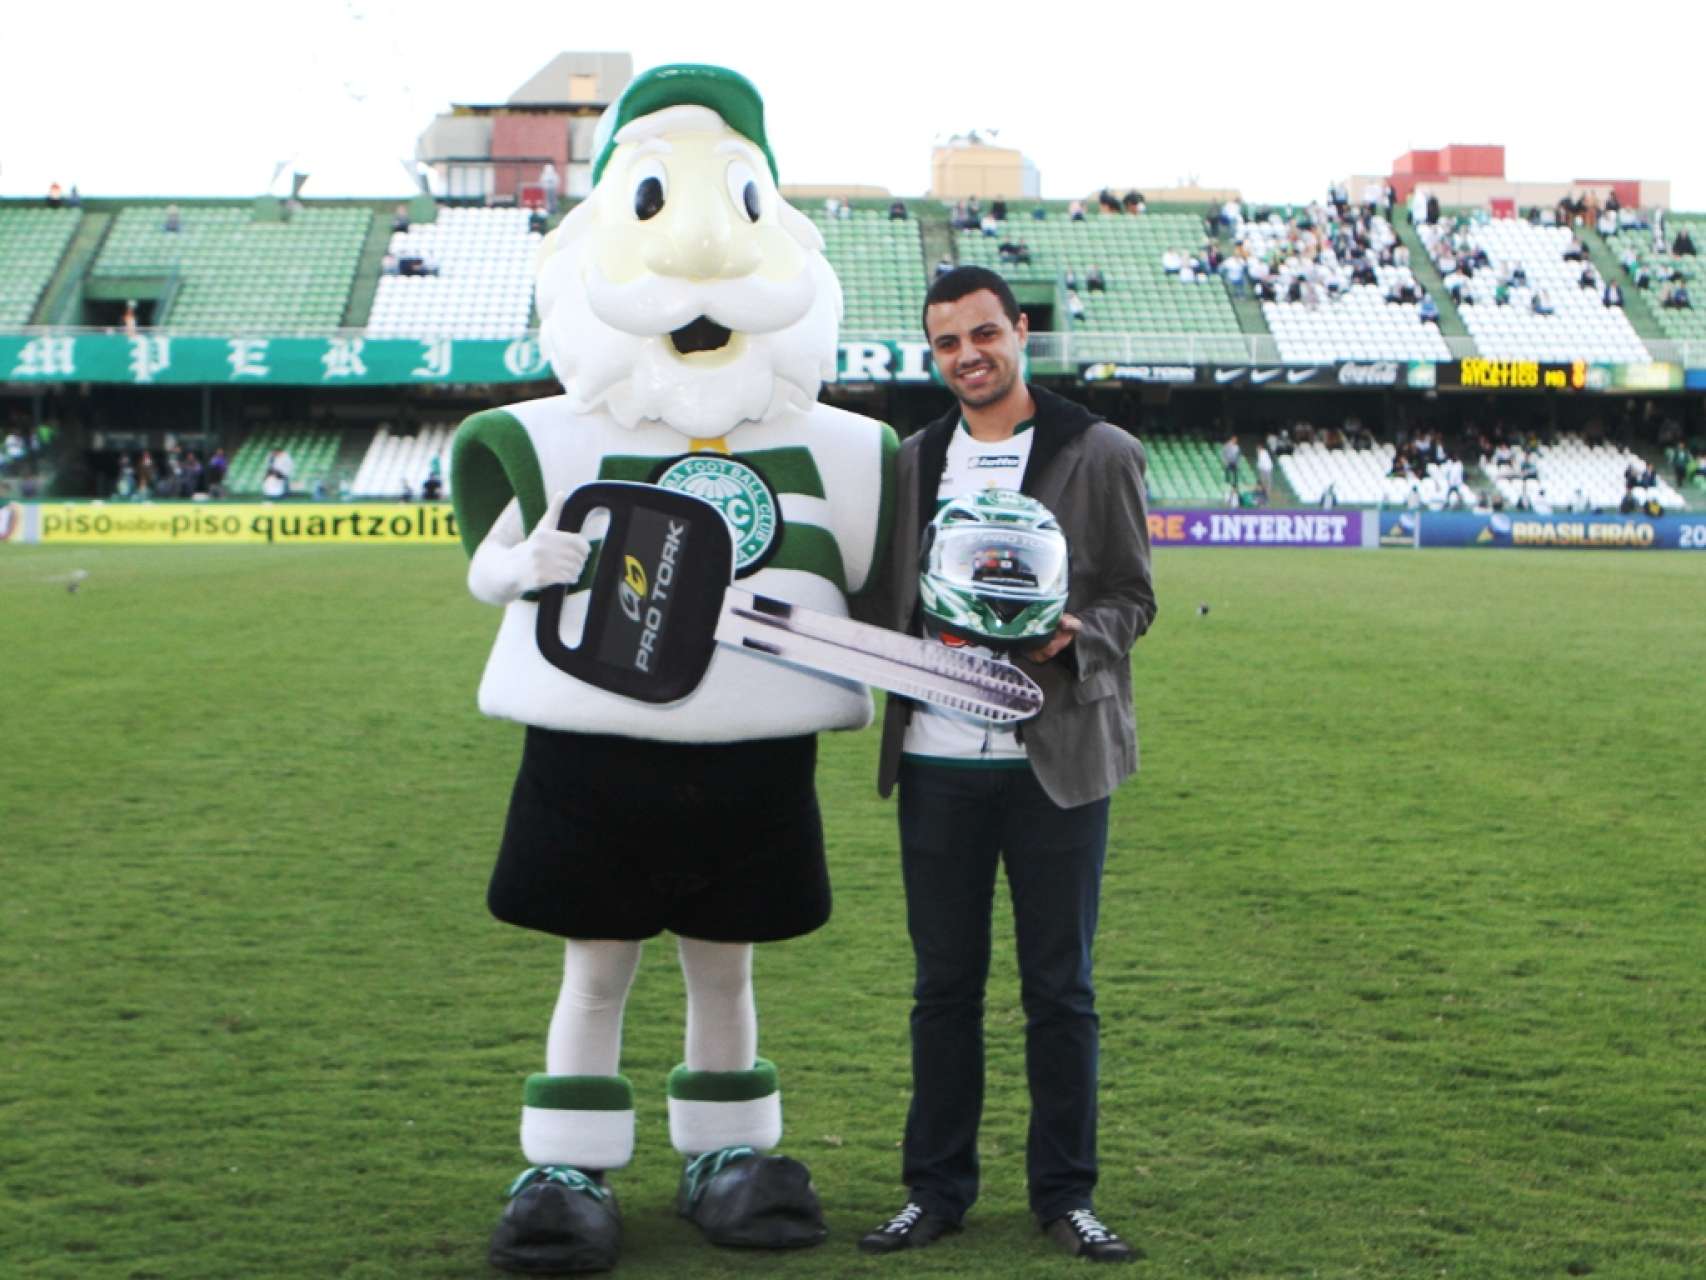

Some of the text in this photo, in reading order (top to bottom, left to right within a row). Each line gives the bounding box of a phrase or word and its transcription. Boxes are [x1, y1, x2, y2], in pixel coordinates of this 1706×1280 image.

[43, 507, 112, 537] piso
[172, 507, 240, 537] piso
[1210, 514, 1348, 541] INTERNET
[1512, 520, 1654, 546] BRASILEIRÃO
[634, 519, 685, 673] PRO TORK
